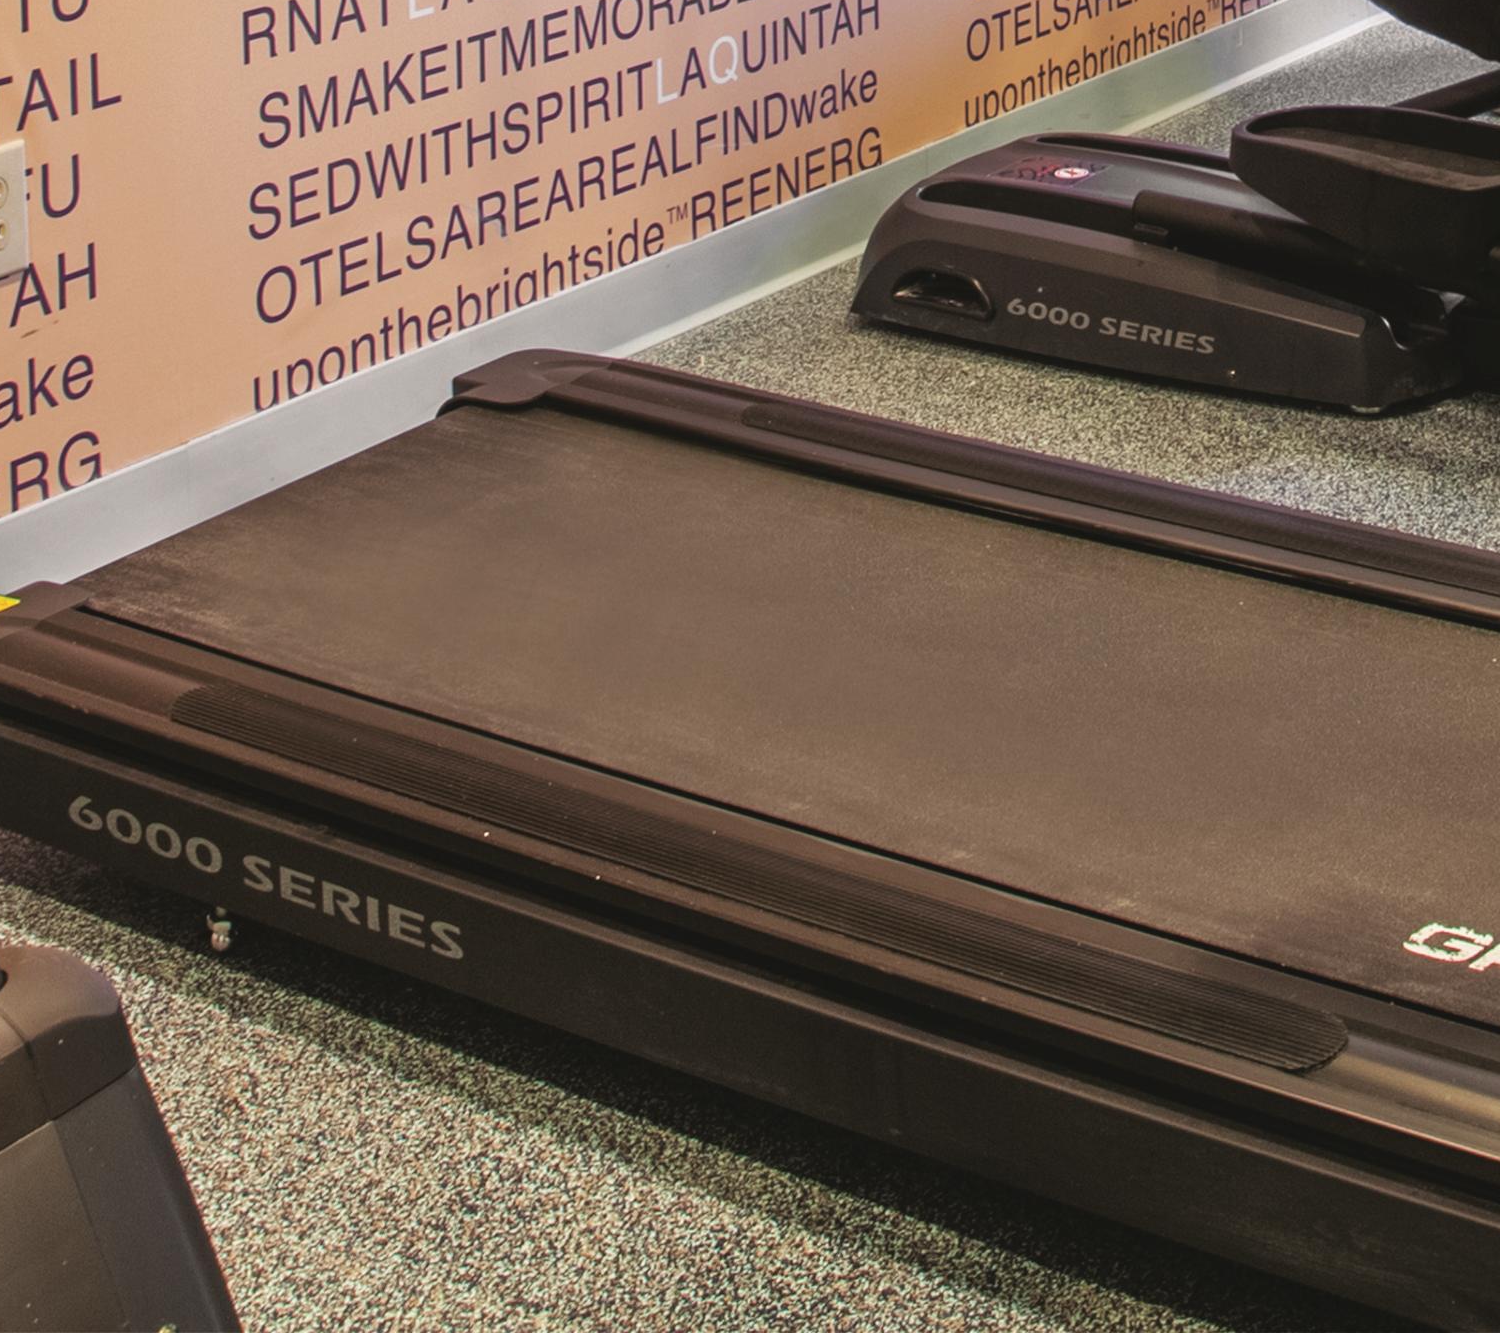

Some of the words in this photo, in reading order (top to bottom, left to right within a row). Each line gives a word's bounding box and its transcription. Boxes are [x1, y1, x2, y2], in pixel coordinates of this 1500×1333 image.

[256, 68, 878, 324] OTELSAREAREALFINDwake
[1005, 296, 1091, 331] 6000
[1098, 316, 1216, 356] SERIES
[67, 794, 223, 875] 6000
[242, 854, 465, 961] SERIES
